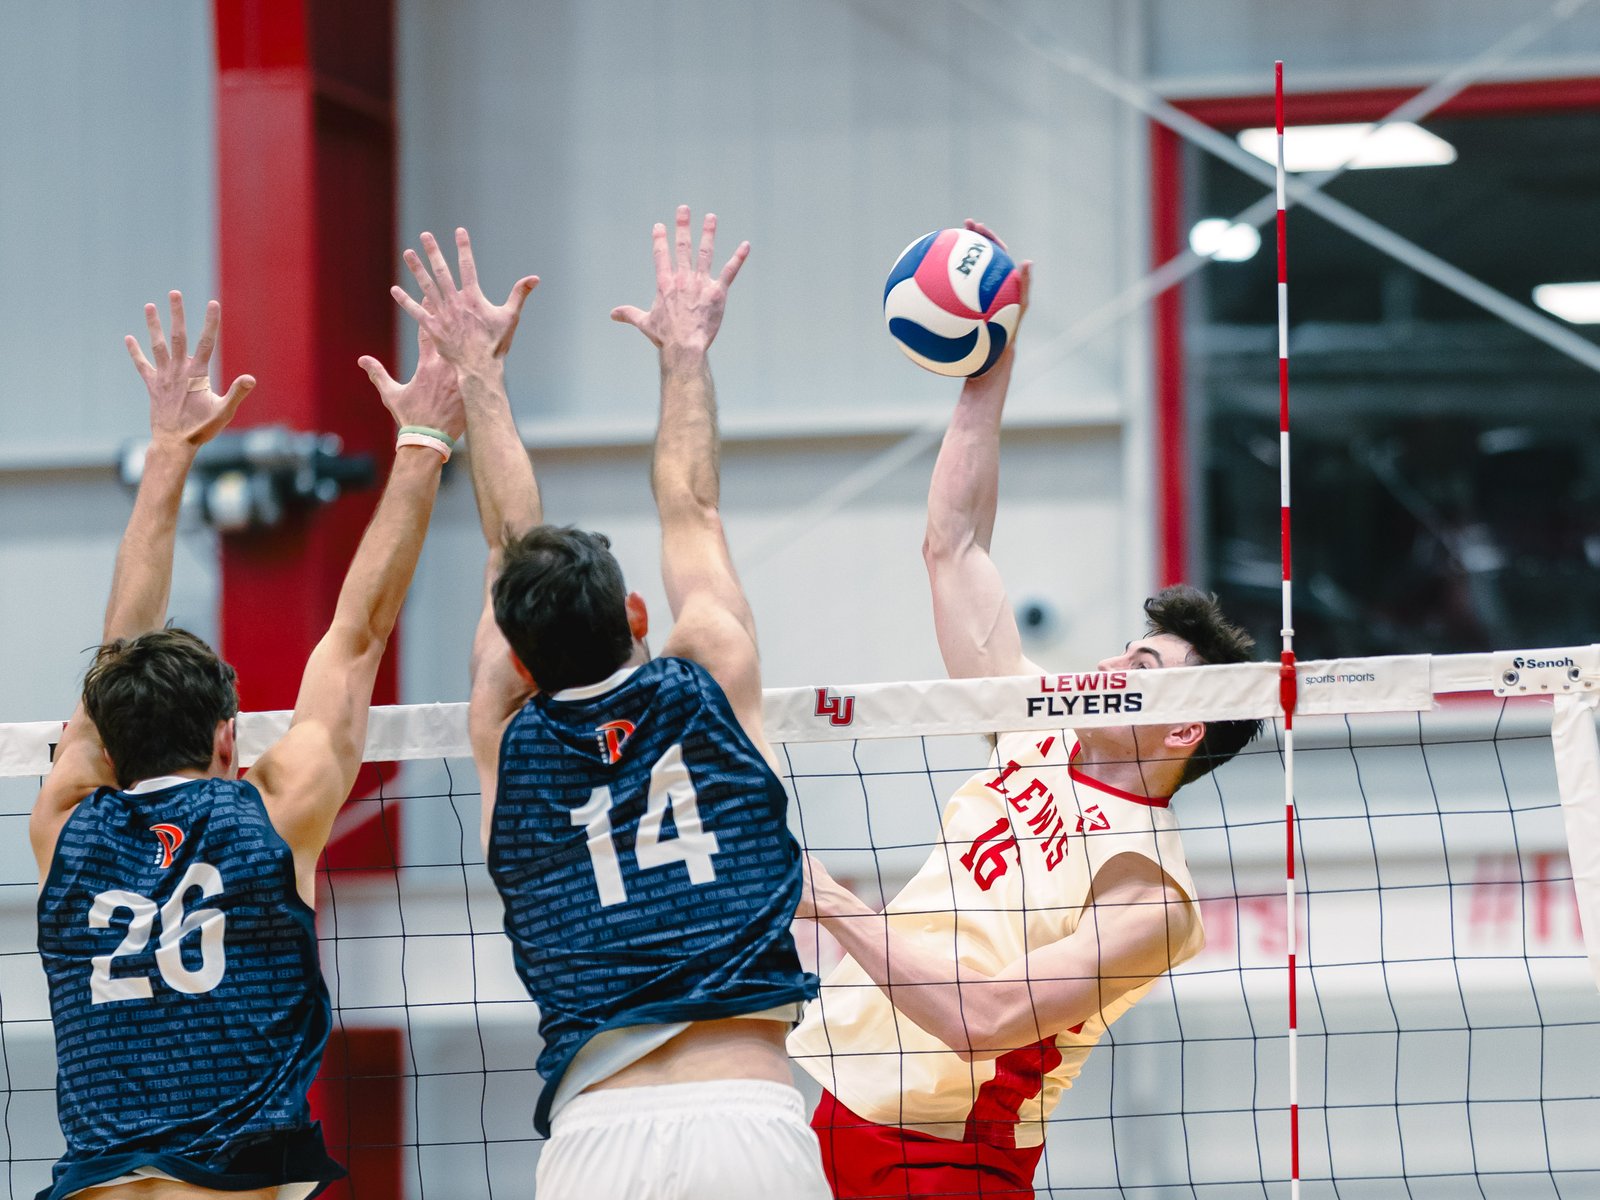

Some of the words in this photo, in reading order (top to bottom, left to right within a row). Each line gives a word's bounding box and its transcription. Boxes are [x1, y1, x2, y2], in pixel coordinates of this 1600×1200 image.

[1040, 672, 1127, 693] LEWIS
[1305, 675, 1336, 684] sports
[1336, 672, 1375, 683] imports
[1526, 657, 1574, 668] Senoh
[1026, 692, 1143, 717] FLYERS
[570, 744, 720, 907] 14
[984, 760, 1068, 872] LEWIS
[959, 817, 1020, 892] 16
[88, 862, 226, 1005] 26
